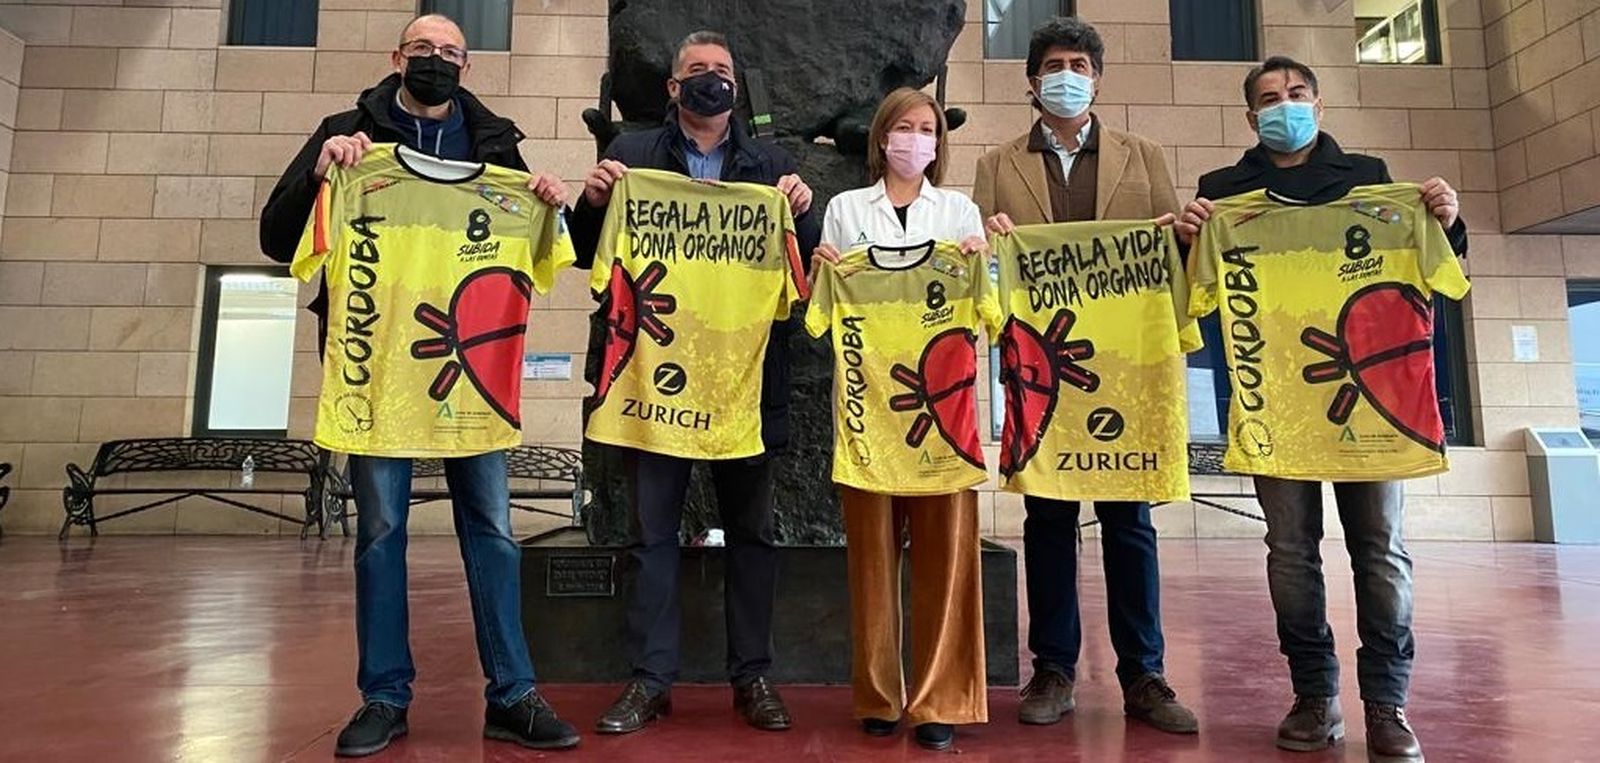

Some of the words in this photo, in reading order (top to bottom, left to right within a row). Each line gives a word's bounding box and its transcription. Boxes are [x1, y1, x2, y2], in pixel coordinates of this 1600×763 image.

[466, 208, 492, 242] 8
[625, 198, 710, 233] REGALA
[718, 203, 776, 235] VIDA,
[456, 241, 500, 256] SUBIDA
[630, 231, 677, 265] DONA
[1345, 224, 1372, 260] 8
[1016, 238, 1109, 284] REGALA
[1337, 255, 1383, 277] SUBIDA
[338, 213, 386, 386] CÓRDOBA
[927, 280, 946, 310] 8
[1028, 275, 1084, 314] DONA
[621, 398, 711, 430] ZURICH
[1056, 452, 1159, 471] ZURICH
